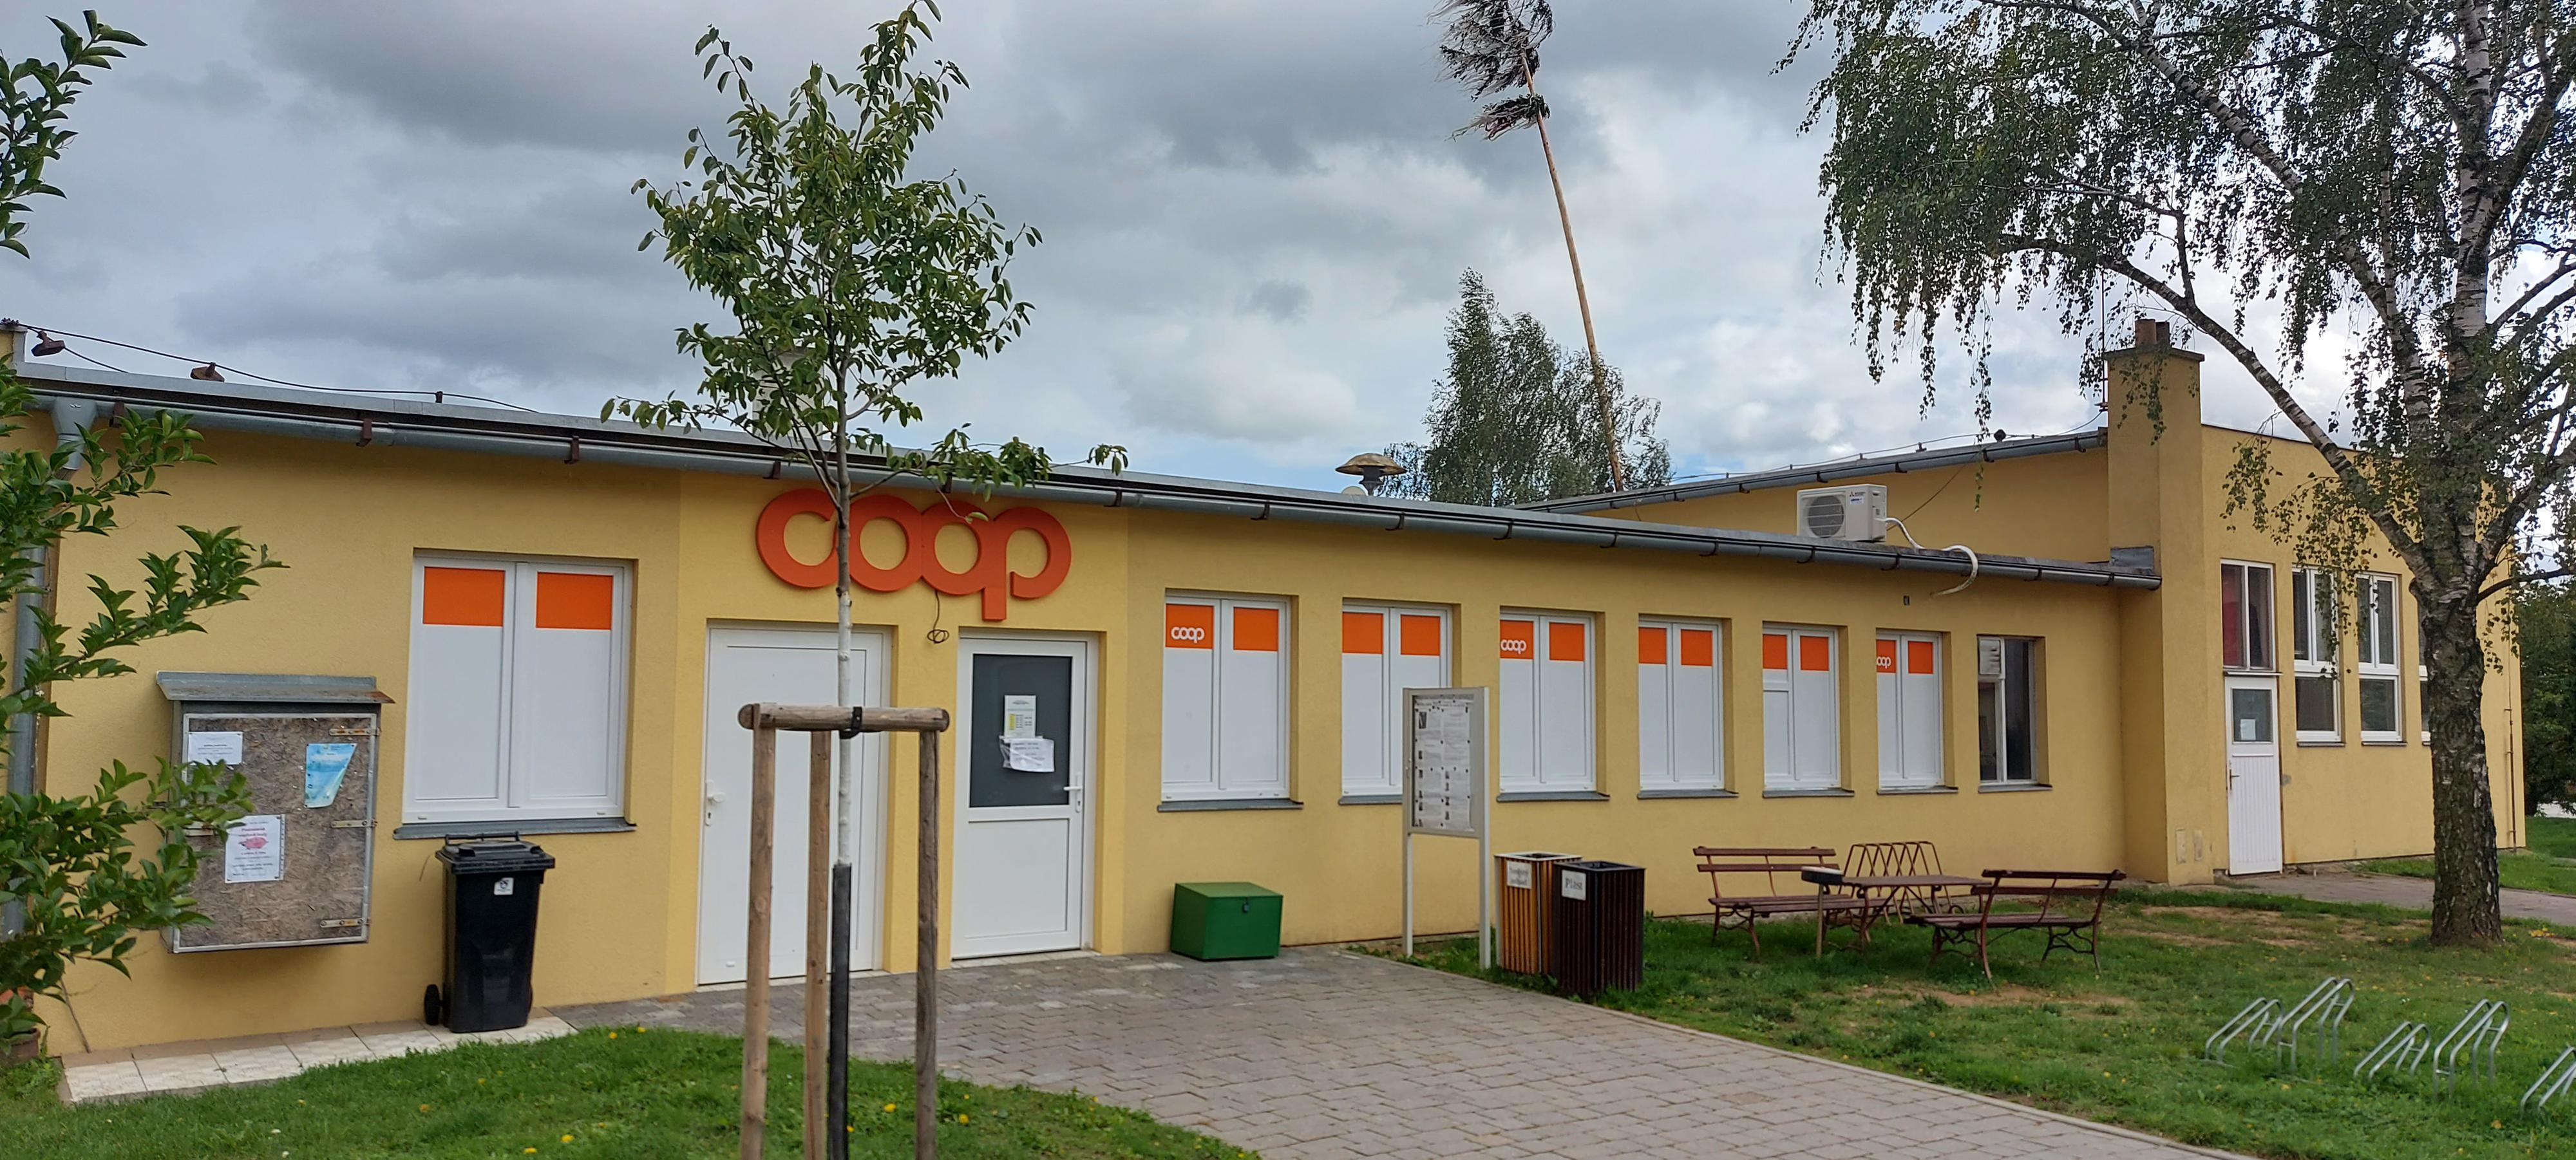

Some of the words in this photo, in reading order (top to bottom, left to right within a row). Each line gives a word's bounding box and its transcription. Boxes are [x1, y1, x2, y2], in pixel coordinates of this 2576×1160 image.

[755, 488, 1072, 622] coop
[1171, 626, 1205, 644] coop
[1501, 639, 1527, 655] coop
[1876, 656, 1891, 669] oop
